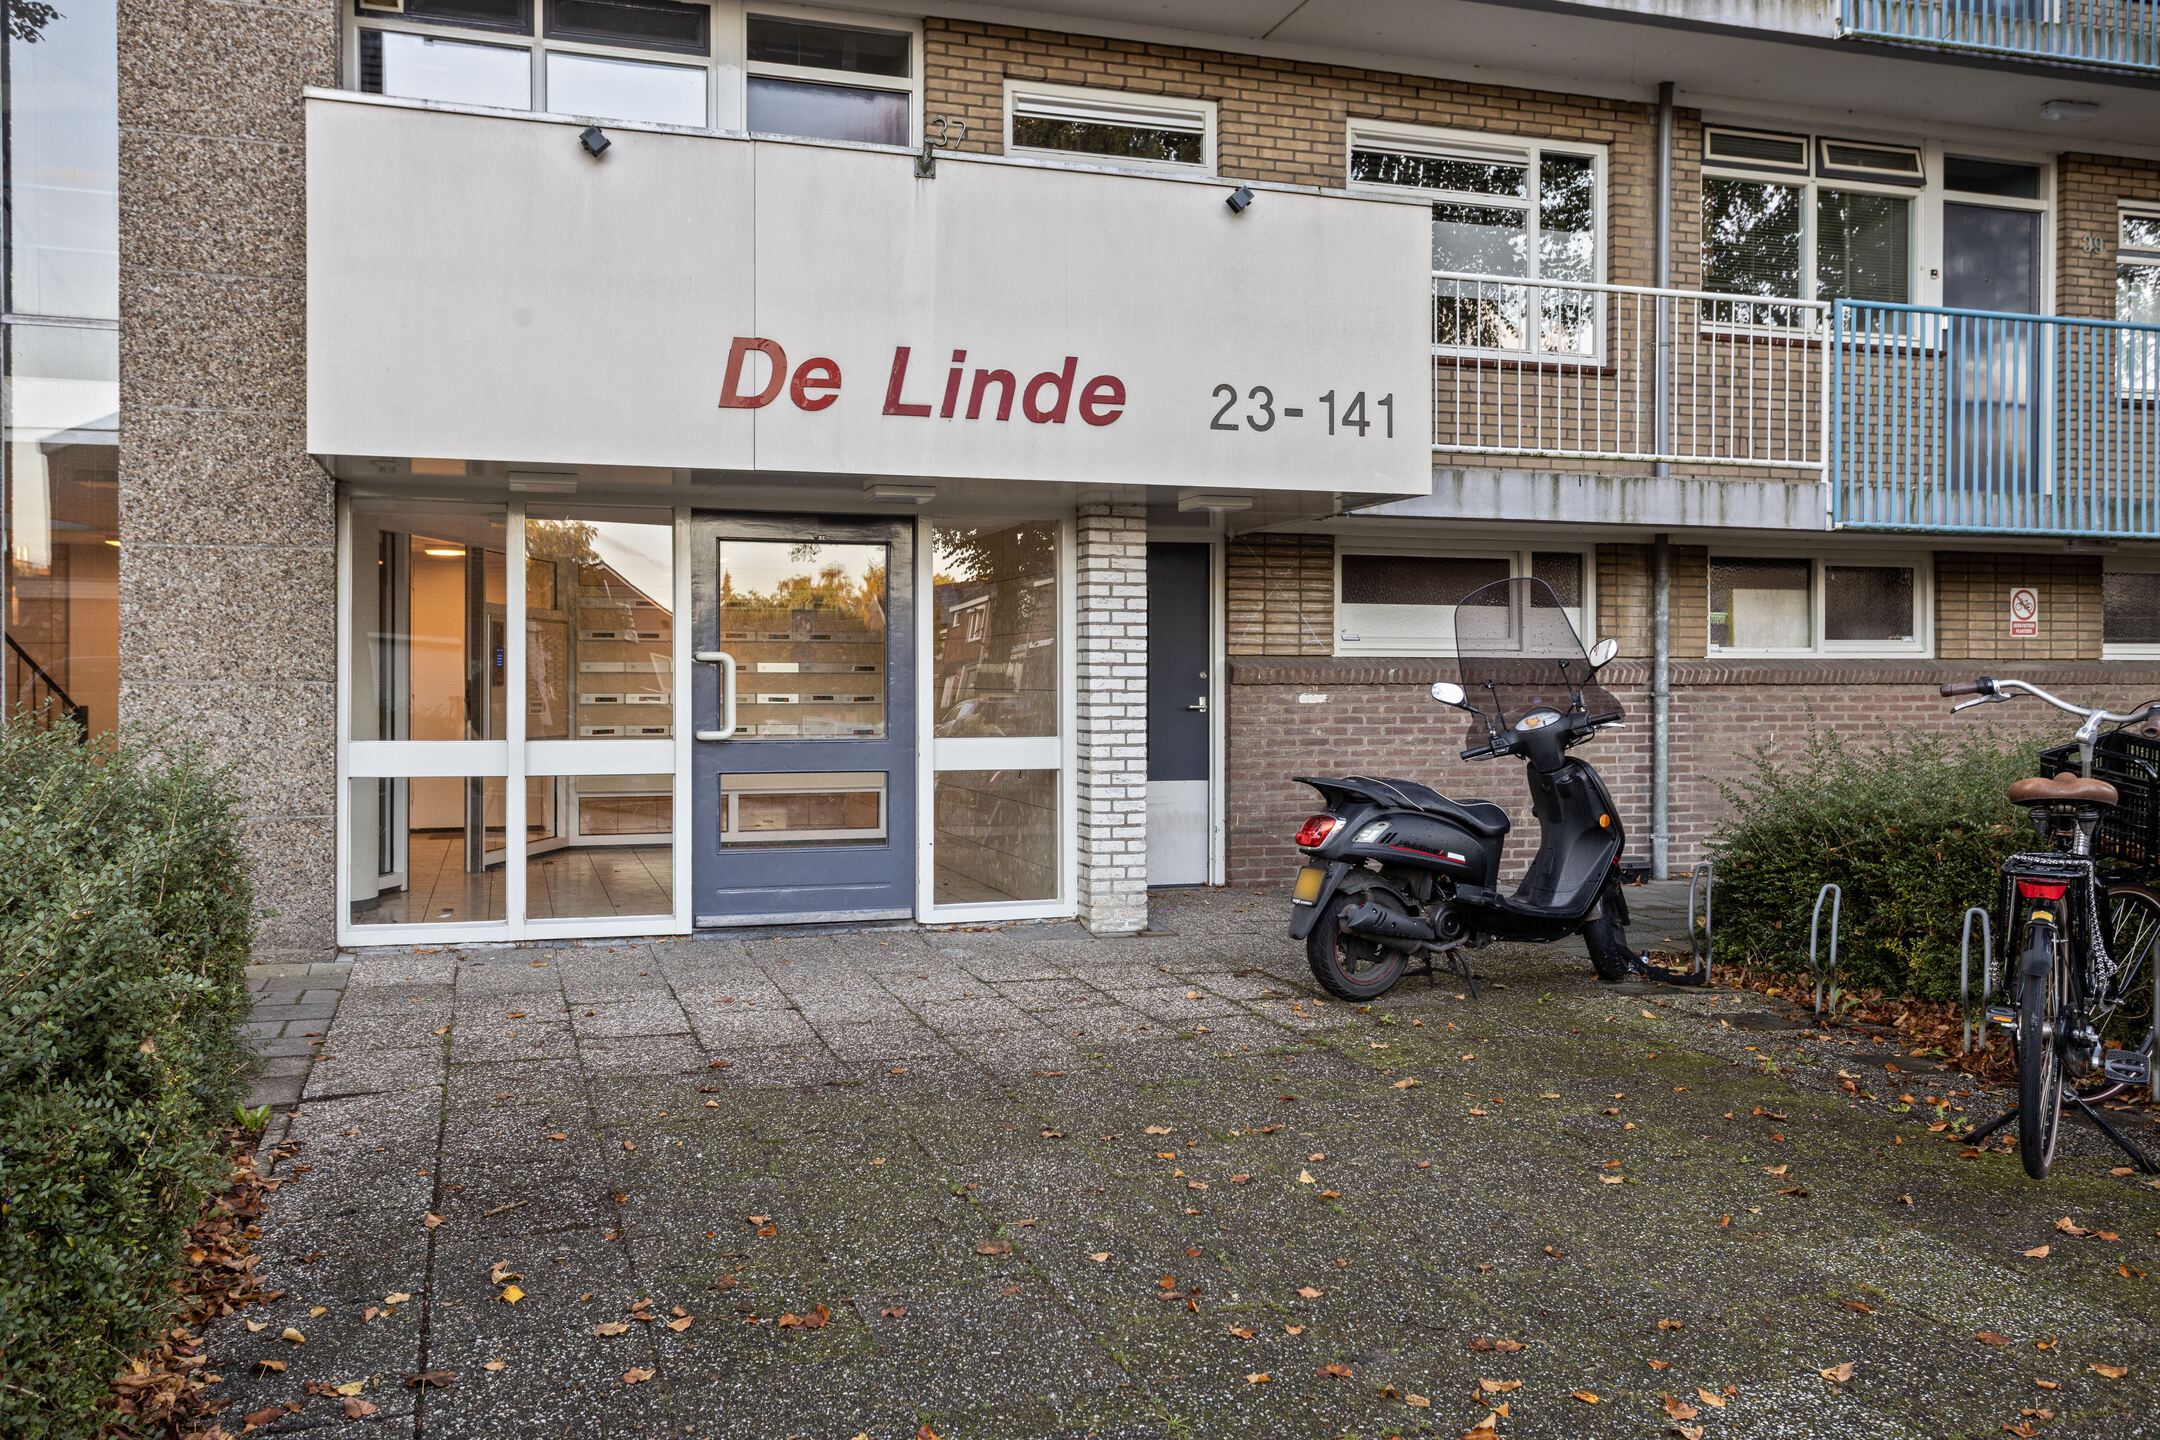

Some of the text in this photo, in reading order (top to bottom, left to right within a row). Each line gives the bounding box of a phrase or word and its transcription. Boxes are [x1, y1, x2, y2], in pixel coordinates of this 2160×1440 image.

[933, 117, 966, 149] 37
[2082, 233, 2104, 255] 39
[720, 338, 1126, 426] De Linde
[1209, 383, 1394, 439] 23-141
